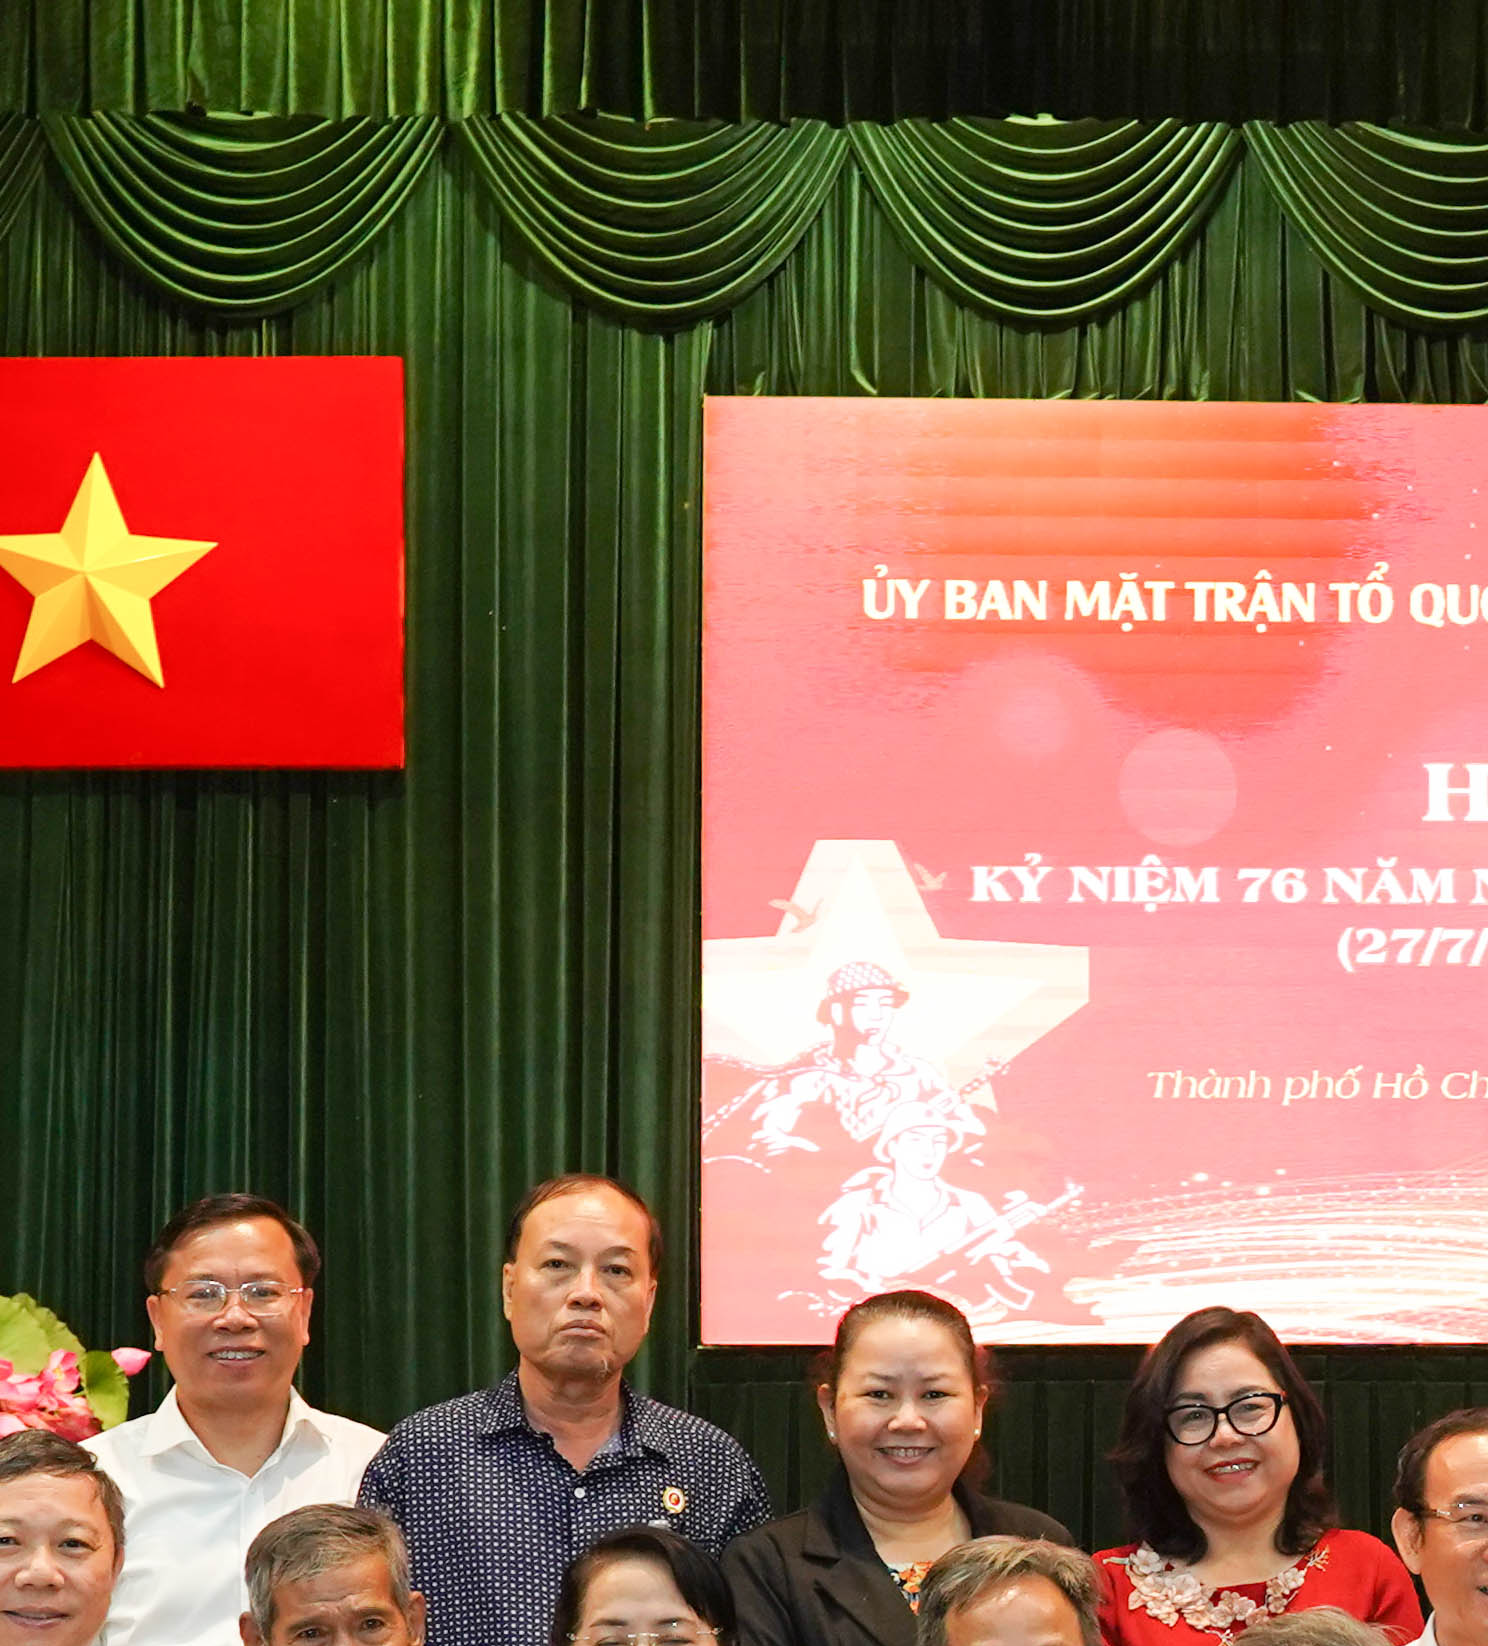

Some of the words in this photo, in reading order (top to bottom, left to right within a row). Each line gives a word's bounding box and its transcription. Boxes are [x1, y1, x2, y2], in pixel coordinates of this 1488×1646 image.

[862, 565, 930, 620] ỦY
[944, 578, 1047, 620] BAN
[1064, 574, 1175, 632] MẶT
[1184, 570, 1315, 633] TRẬN
[1329, 561, 1394, 624] TỔ
[970, 853, 1052, 903] KỶ
[1069, 854, 1220, 912] NIỆM
[1237, 867, 1307, 903] 76
[1322, 858, 1455, 904] NĂM
[1147, 1068, 1271, 1099] Thành
[1282, 1064, 1364, 1106] phố
[1372, 1064, 1430, 1099] Hồ
